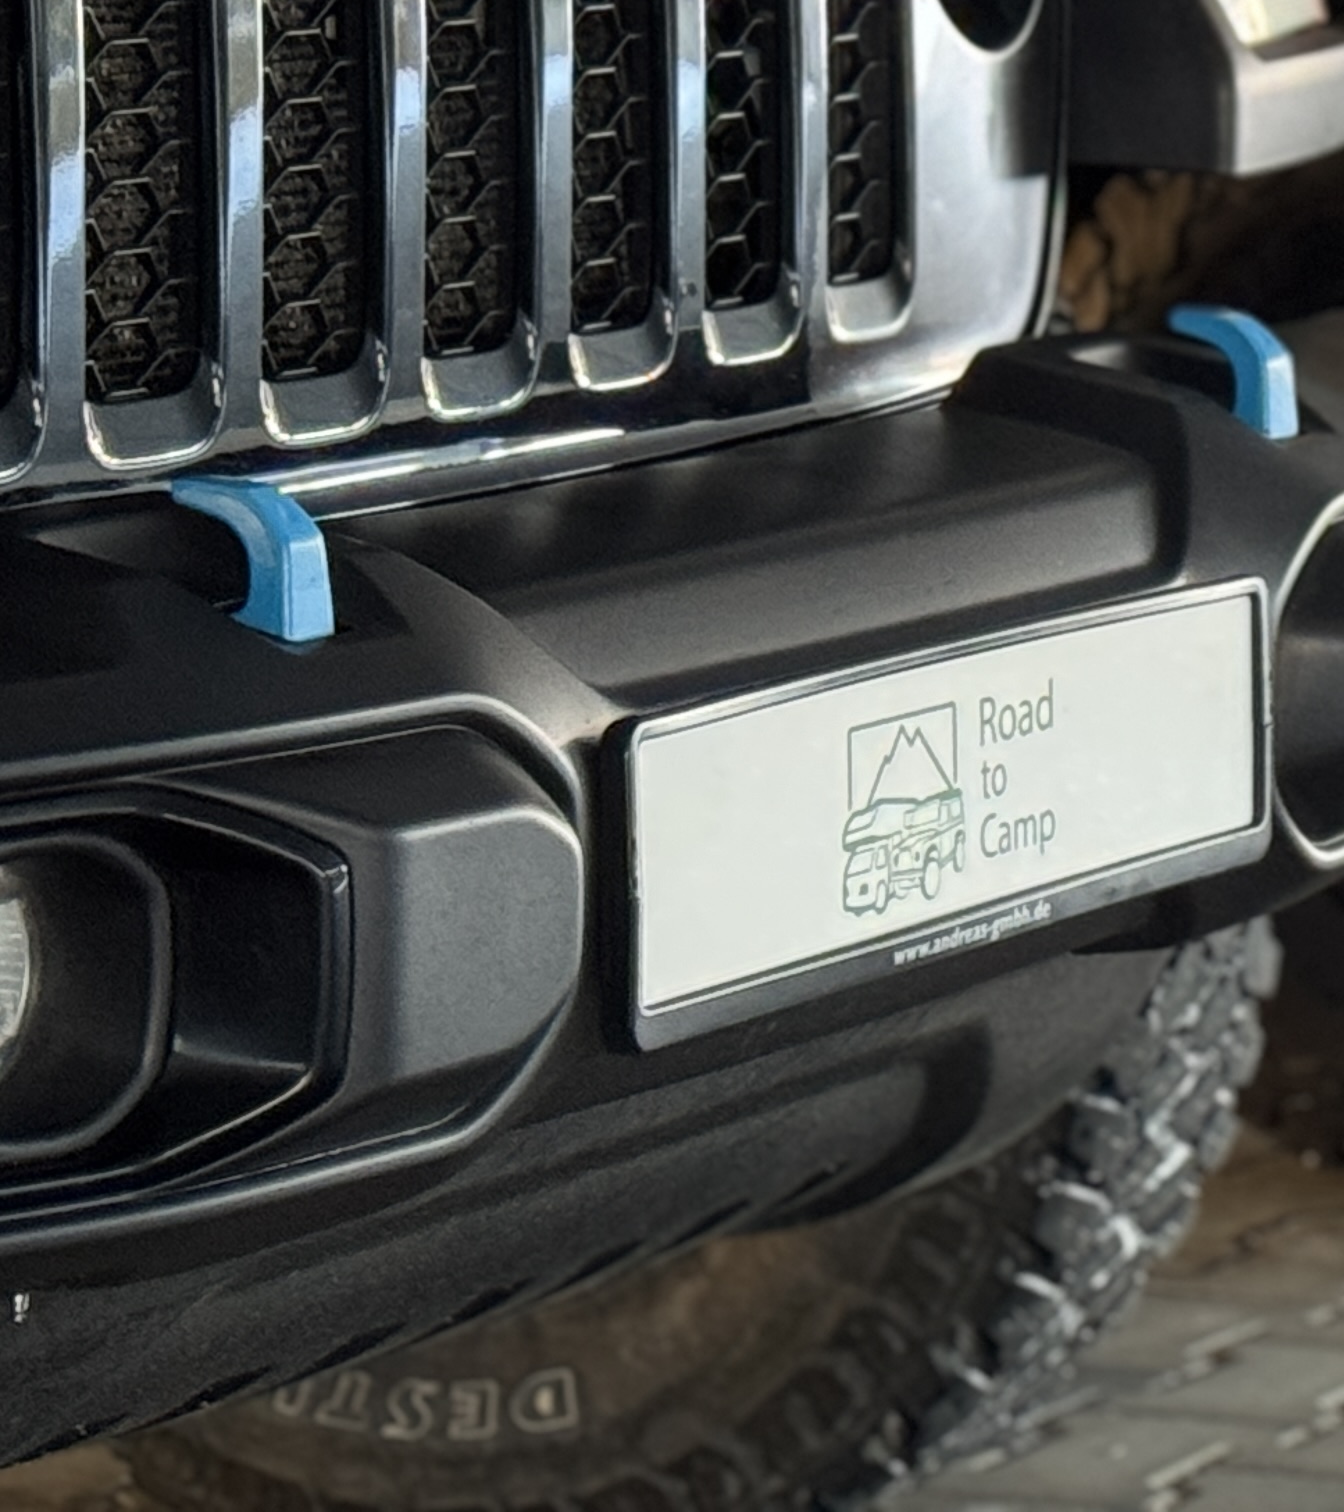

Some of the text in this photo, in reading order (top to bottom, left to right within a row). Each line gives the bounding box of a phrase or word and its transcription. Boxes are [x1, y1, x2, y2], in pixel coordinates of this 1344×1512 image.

[979, 678, 1055, 746] Road
[981, 760, 1007, 800] to
[980, 808, 1055, 859] Camp
